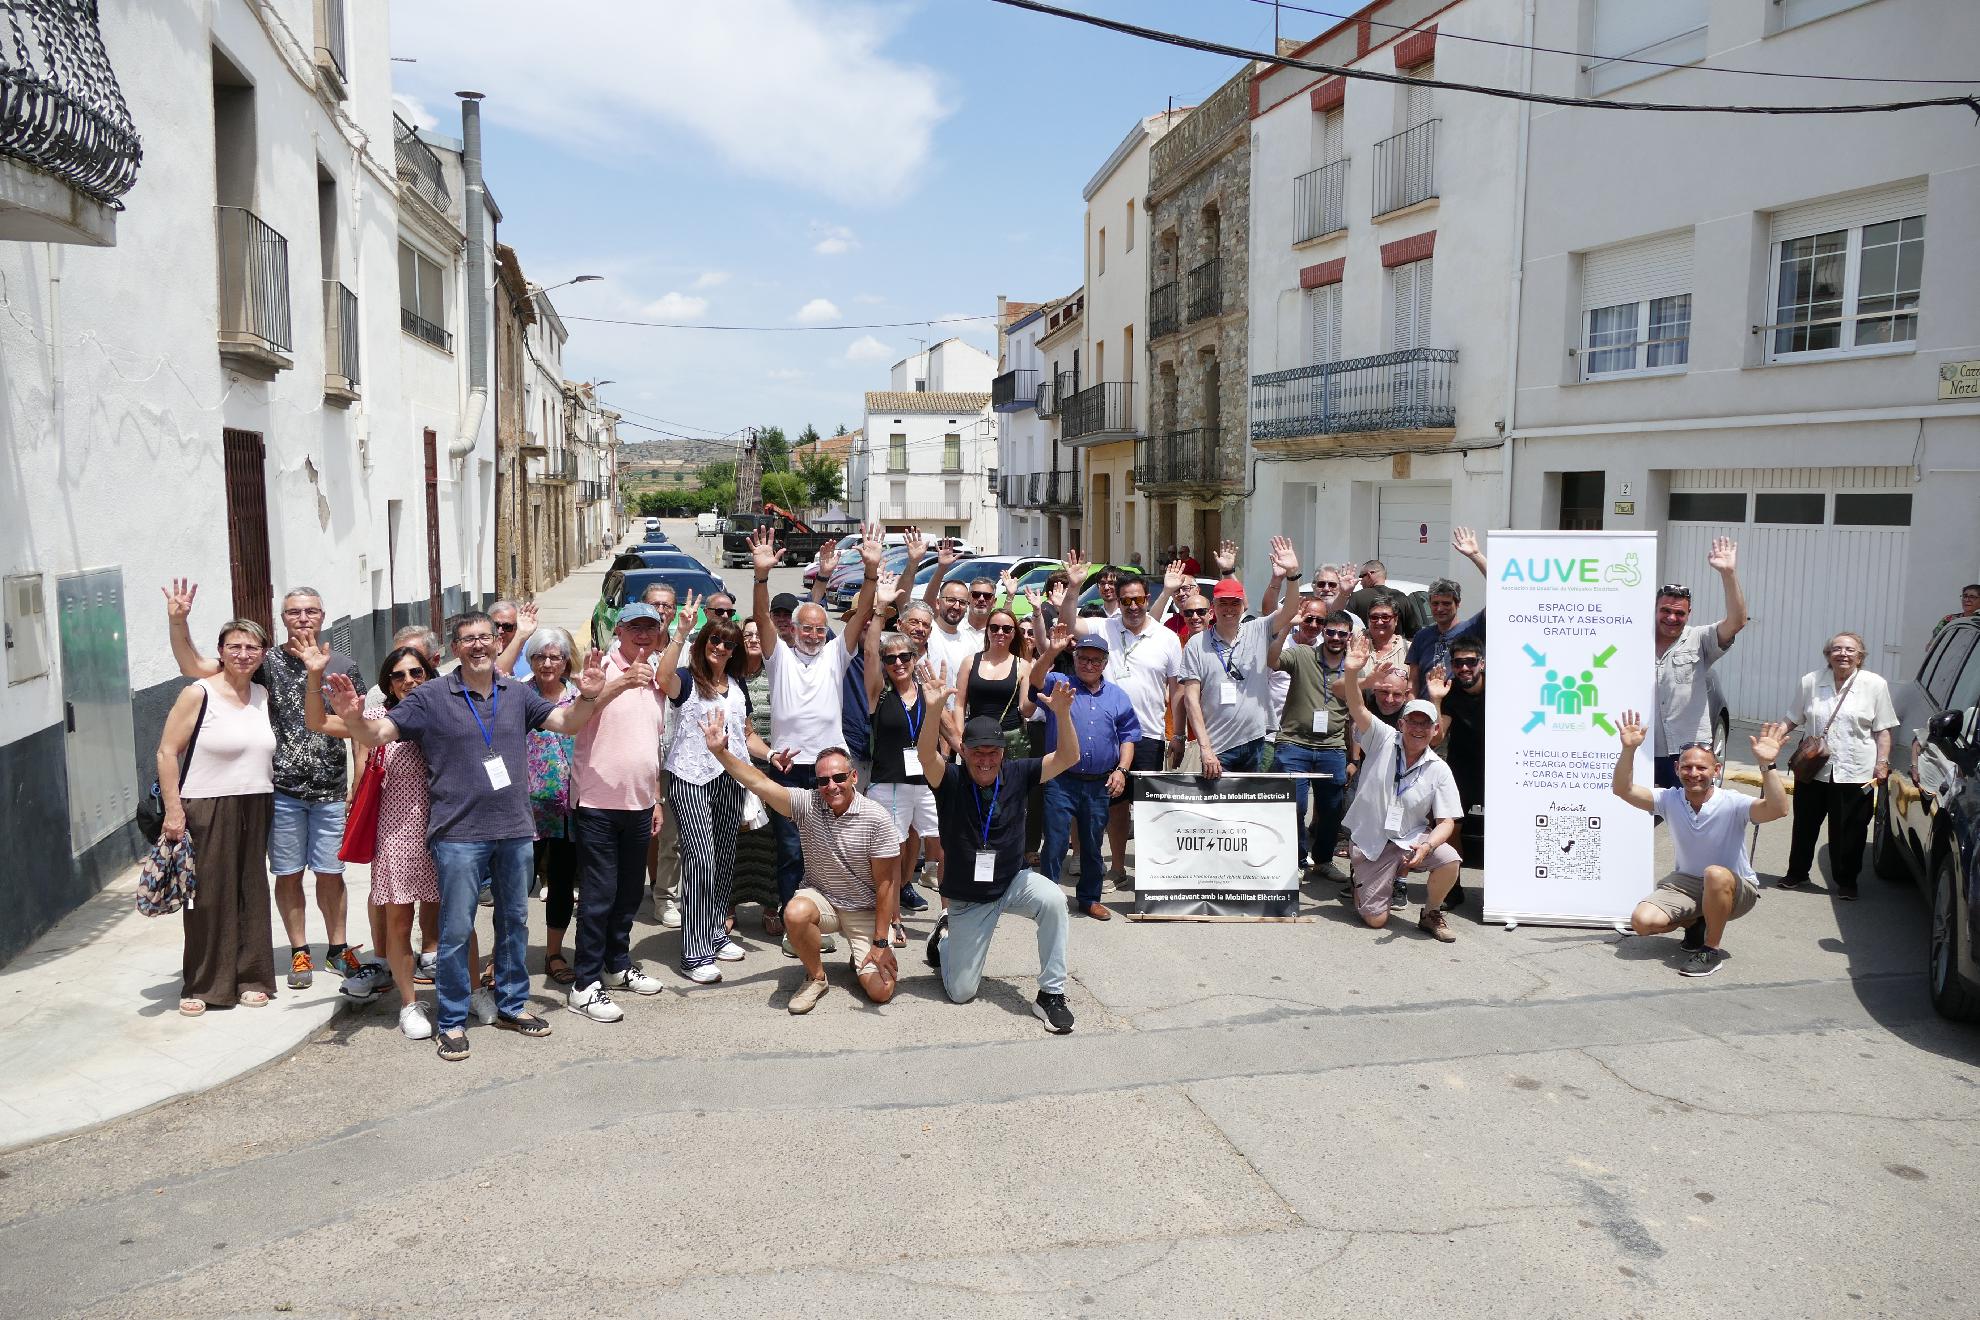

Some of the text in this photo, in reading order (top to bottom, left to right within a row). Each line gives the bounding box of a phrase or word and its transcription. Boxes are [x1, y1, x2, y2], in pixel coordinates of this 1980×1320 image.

[1960, 364, 1980, 377] Carr
[1623, 483, 1630, 494] 2
[1501, 557, 1600, 583] AUVE
[1538, 603, 1602, 612] ESPACIO DE
[1508, 614, 1633, 625] CONSULTA Y ASESORÍA
[1543, 627, 1597, 636] GRATUITA
[1568, 761, 1616, 770] DOMÉSTIC
[1532, 771, 1564, 779] CARGA
[1581, 772, 1613, 780] VIAJES
[1523, 780, 1614, 790] AYUDAS A LA COMP
[1145, 791, 1172, 800] Sempre
[1227, 792, 1257, 800] Mobilitat
[1176, 837, 1248, 852] VOLT TOUR
[1144, 893, 1169, 901] Sempre
[1170, 893, 1200, 901] endavant
[1225, 893, 1256, 901] Mobilitat
